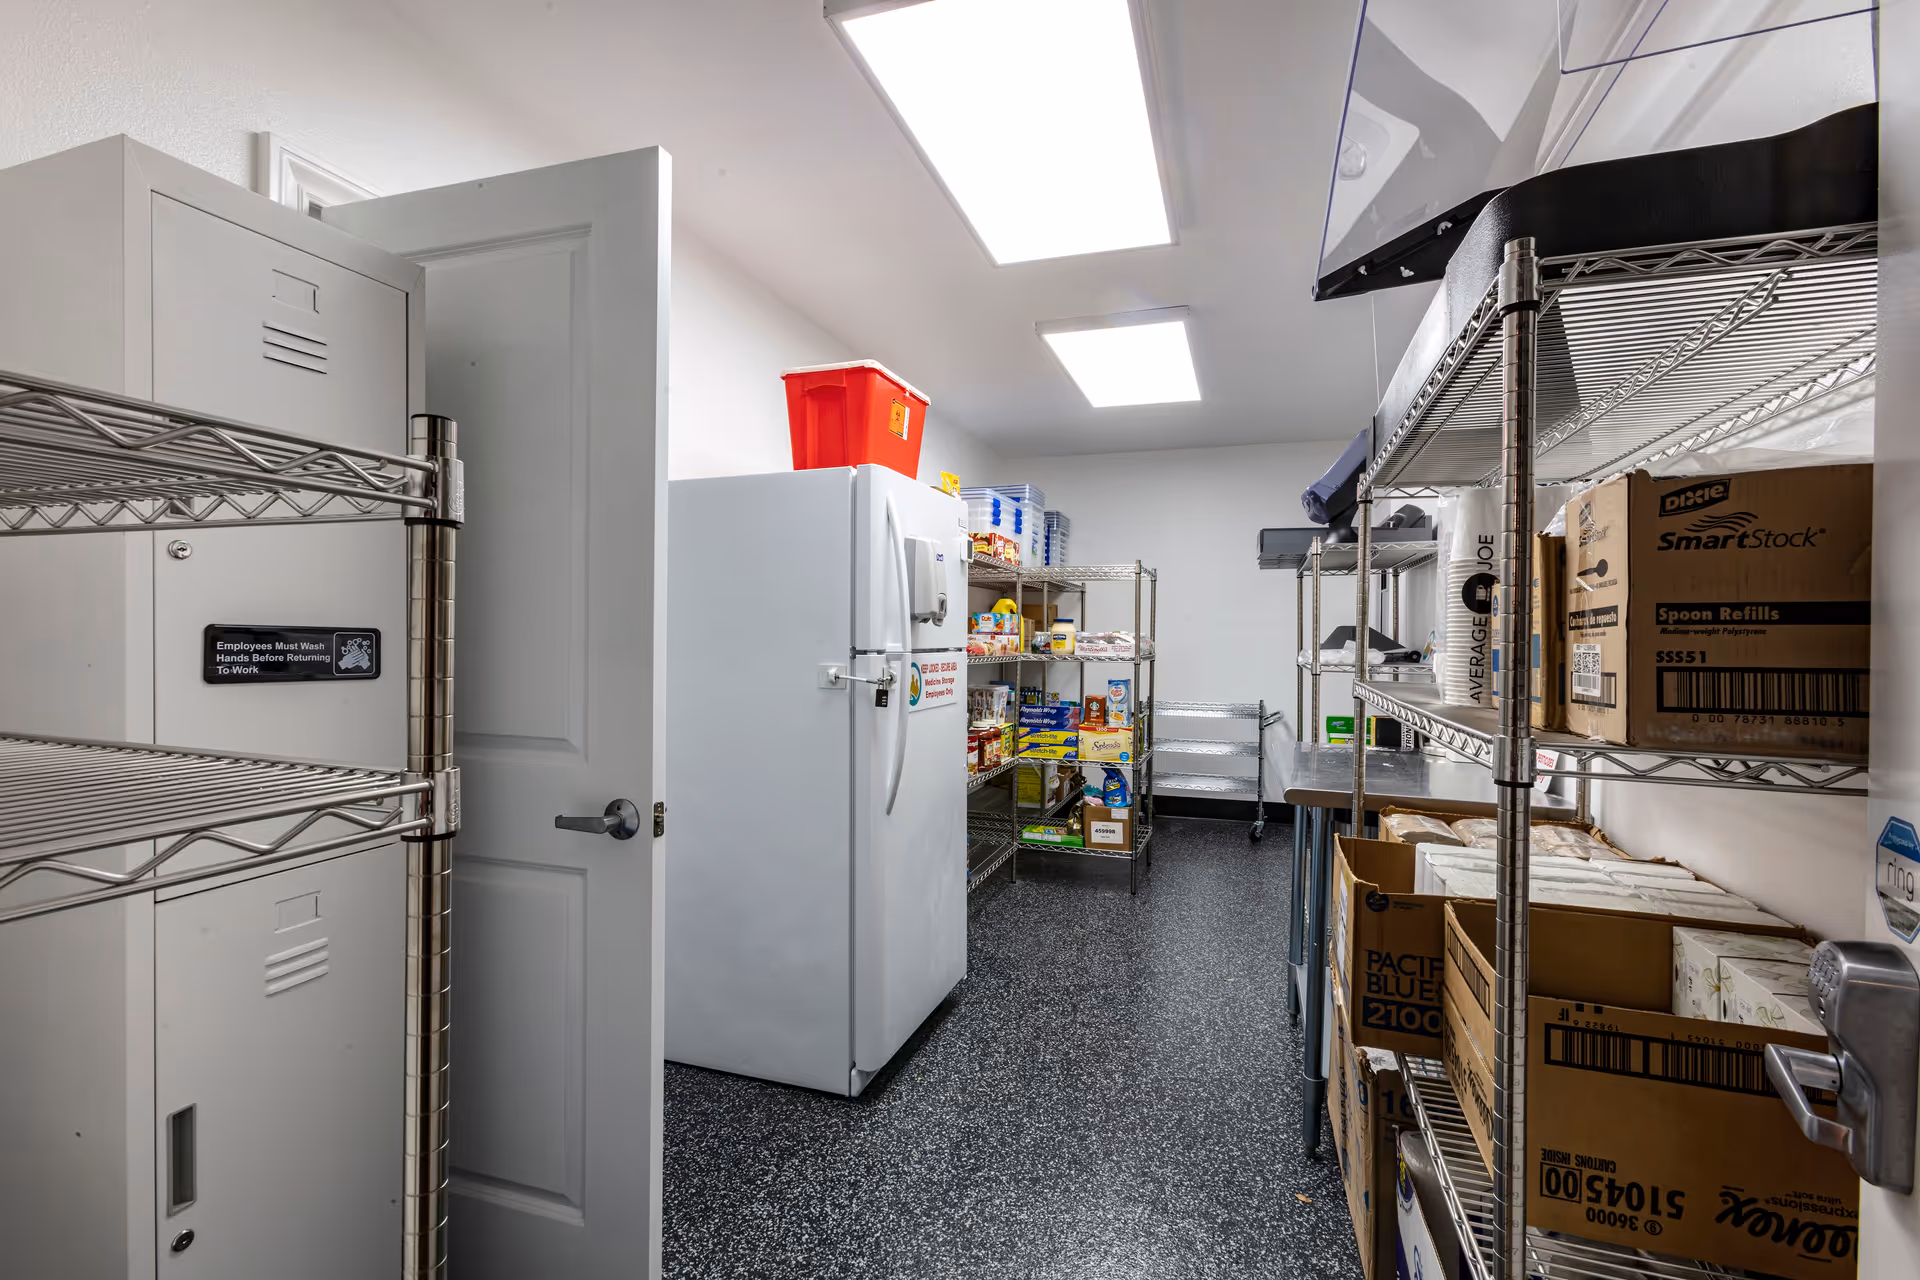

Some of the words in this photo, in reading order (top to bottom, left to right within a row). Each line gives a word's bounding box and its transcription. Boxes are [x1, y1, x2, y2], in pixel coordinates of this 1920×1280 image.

[1657, 526, 1818, 551] SmartStock
[1477, 534, 1494, 571] JOE
[1596, 611, 1617, 627] repuesto
[1658, 607, 1713, 624] Spoon
[1719, 605, 1780, 621] Refills
[1722, 627, 1768, 636] Polystyrene
[216, 641, 273, 652] Employees
[275, 642, 299, 650] Must
[300, 642, 325, 650] Wash
[216, 653, 250, 662] Hands
[252, 653, 284, 662] Before
[286, 653, 331, 663] Returning
[1469, 616, 1488, 704] AVERAGE
[1656, 650, 1706, 664] SSS51
[216, 665, 230, 675] To
[232, 665, 259, 675] Work
[925, 678, 941, 686] Medicine
[942, 677, 955, 685] Storage
[926, 689, 945, 699] Employees
[1020, 706, 1043, 714] Reynolds
[1020, 717, 1043, 725] Reynolds
[1043, 718, 1057, 726] Wrap
[1692, 714, 1699, 723] 0
[1708, 714, 1724, 723] 00
[1734, 715, 1775, 725] 78731
[1784, 716, 1827, 726] 88810
[1838, 718, 1845, 727] 5
[1091, 740, 1121, 752] Splenda
[1887, 857, 1915, 903] ring
[1365, 971, 1438, 1001] BLUE
[1687, 1034, 1725, 1046] 51045
[1540, 1148, 1571, 1165] INSIDE
[1574, 1154, 1616, 1174] CARTONS
[1544, 1167, 1578, 1199] 00
[1585, 1174, 1685, 1220] 51045
[1793, 1191, 1815, 1202] soft
[1817, 1195, 1842, 1206] ultra
[1585, 1207, 1638, 1231] 36000
